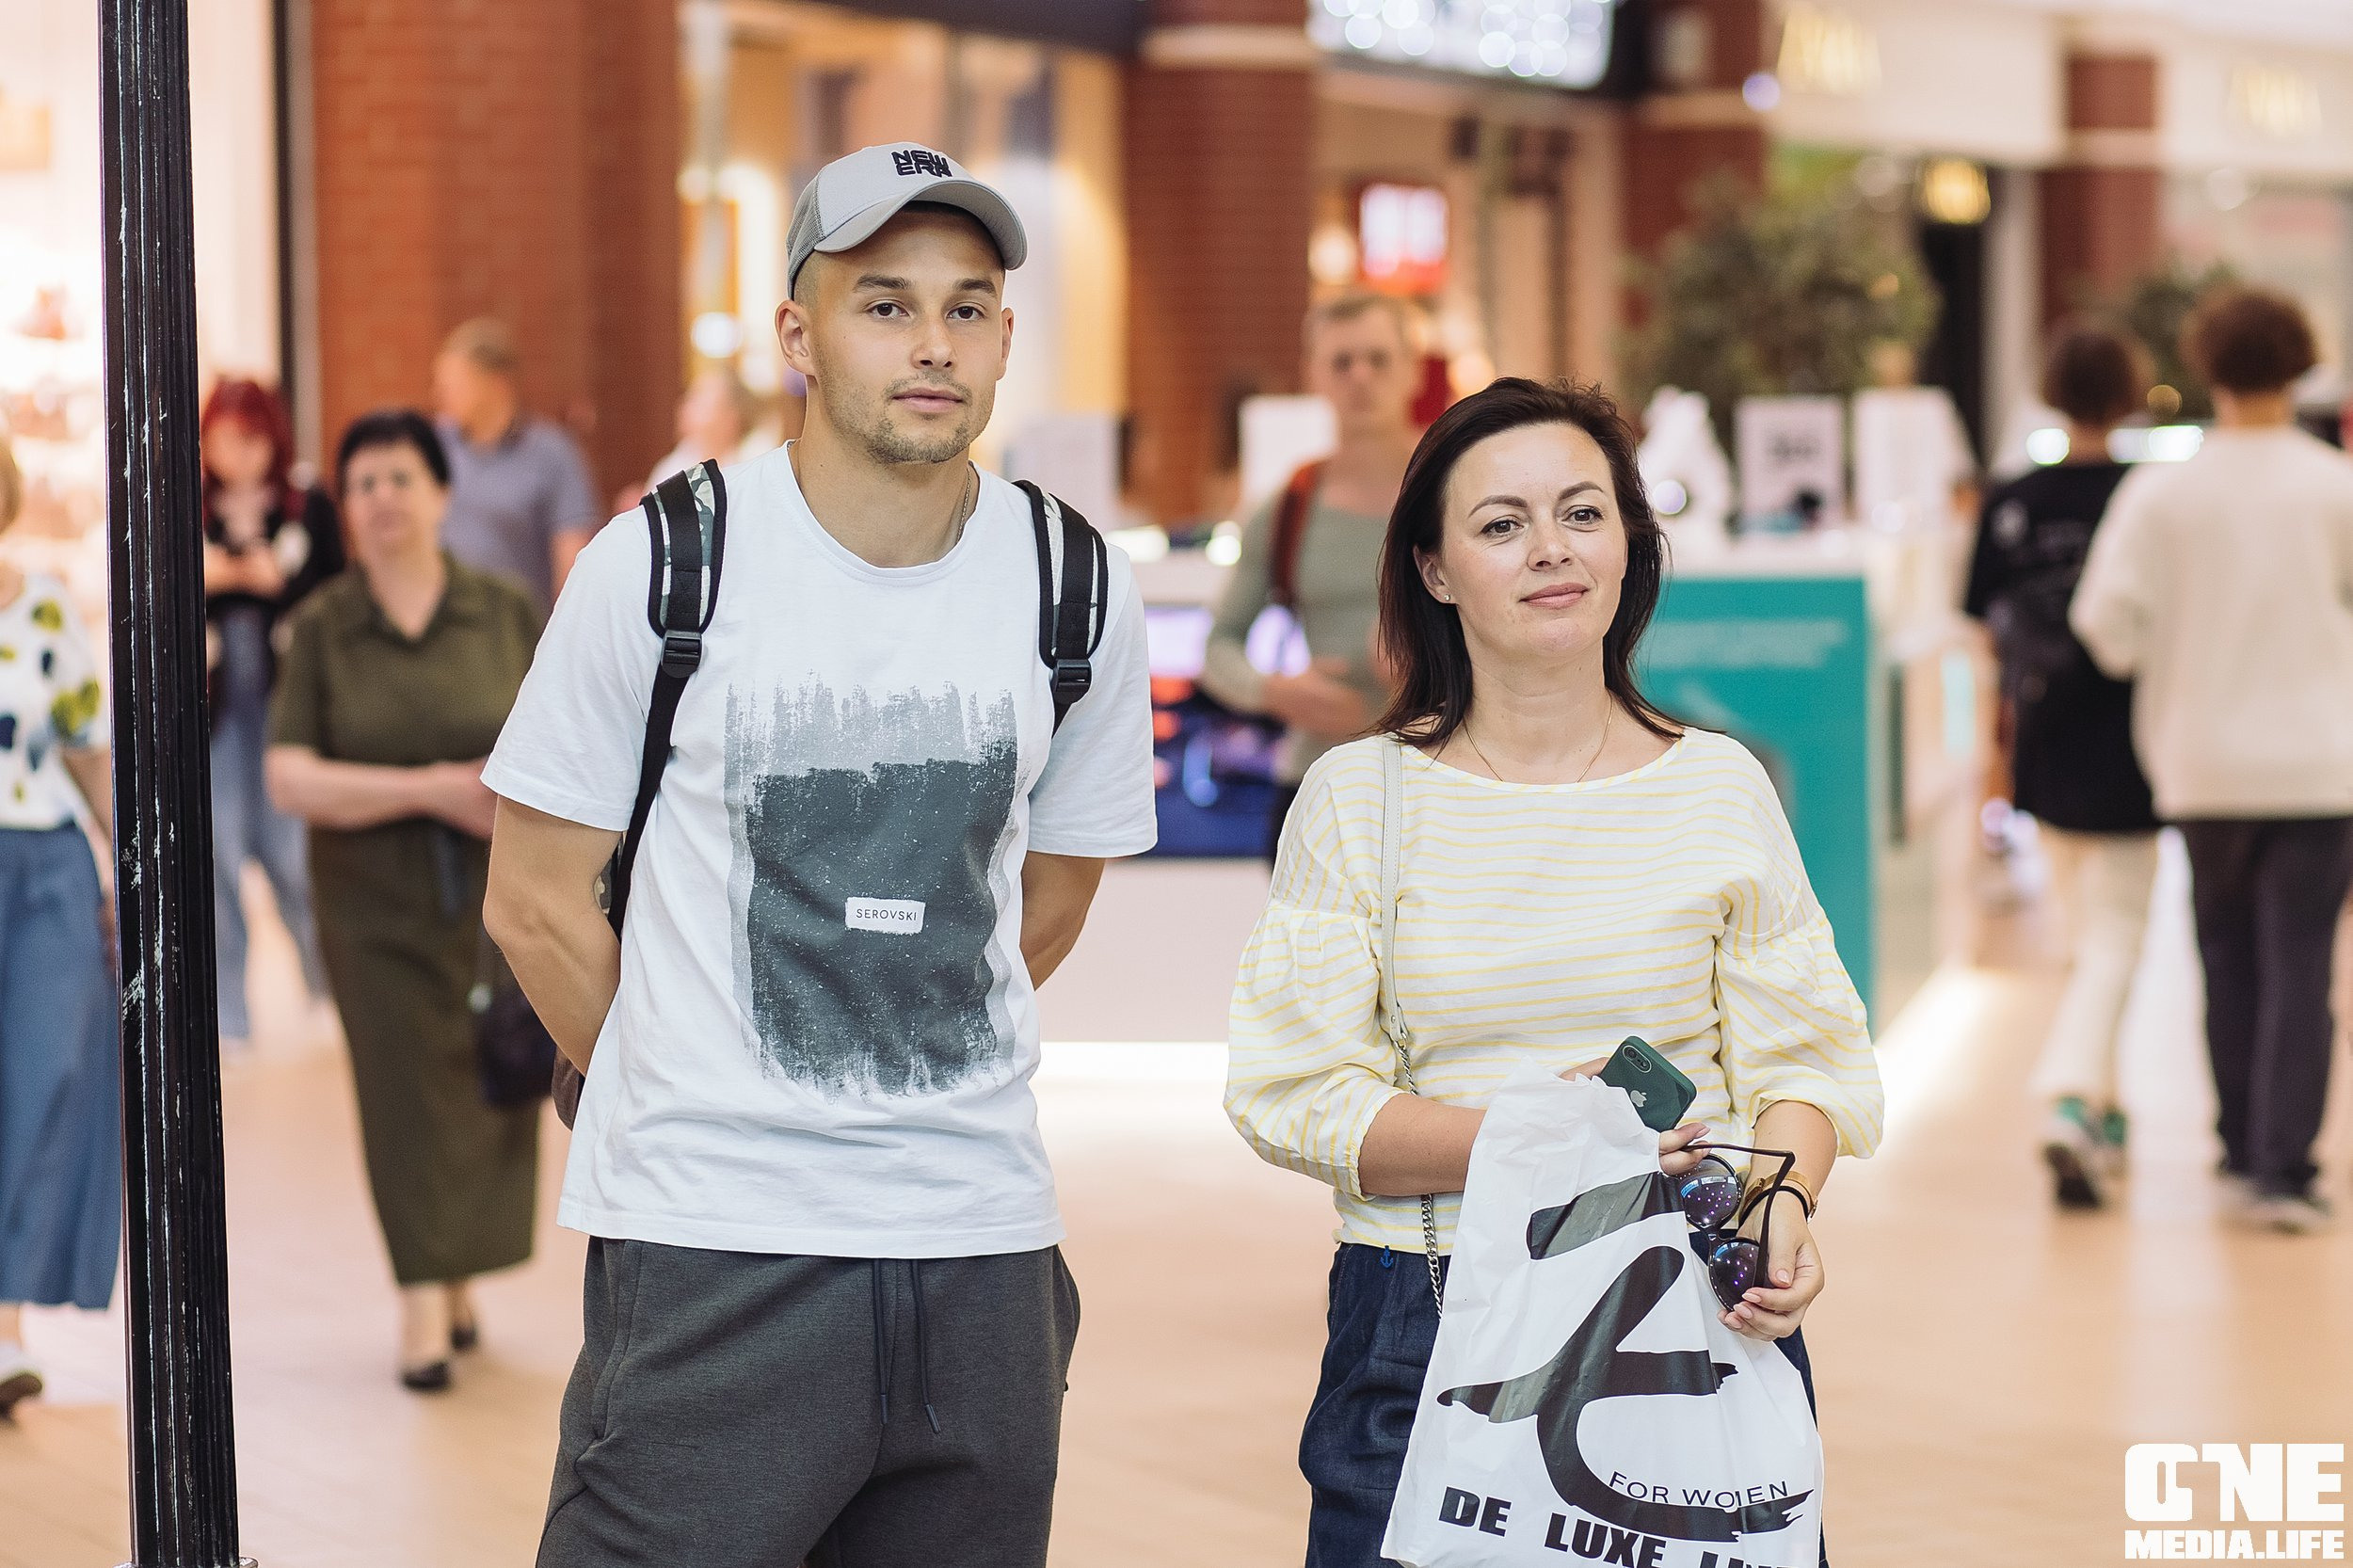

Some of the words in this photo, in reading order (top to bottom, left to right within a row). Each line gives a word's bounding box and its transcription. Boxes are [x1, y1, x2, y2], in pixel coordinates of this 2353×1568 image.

[890, 150, 949, 169] NEW
[895, 161, 952, 178] ERA
[856, 908, 917, 921] SEROVSKI
[1609, 1470, 1669, 1504] FOR
[1438, 1486, 1513, 1538] DE
[1544, 1512, 1667, 1568] LUXE
